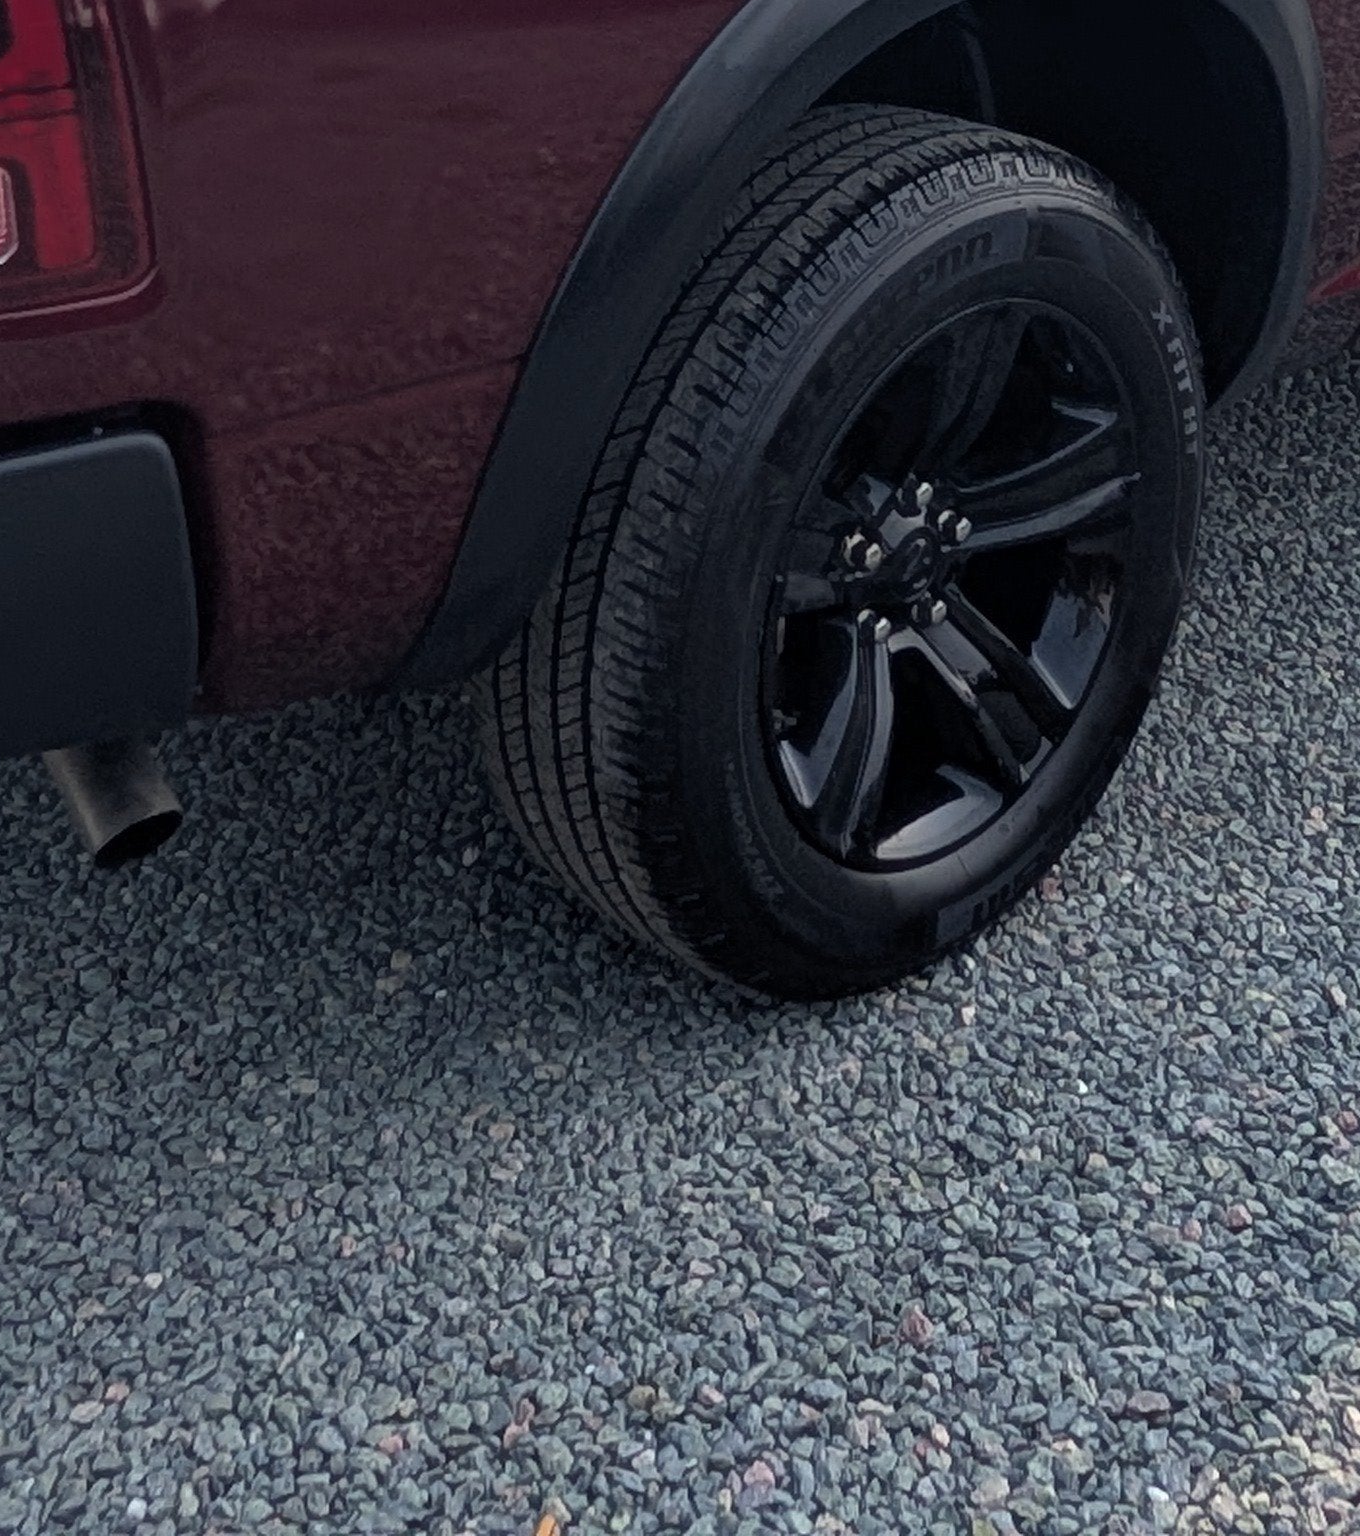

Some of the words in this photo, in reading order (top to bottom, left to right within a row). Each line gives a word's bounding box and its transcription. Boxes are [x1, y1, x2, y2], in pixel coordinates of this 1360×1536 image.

[1151, 300, 1173, 334] X
[1167, 338, 1193, 392] FIT
[1184, 407, 1198, 458] HT
